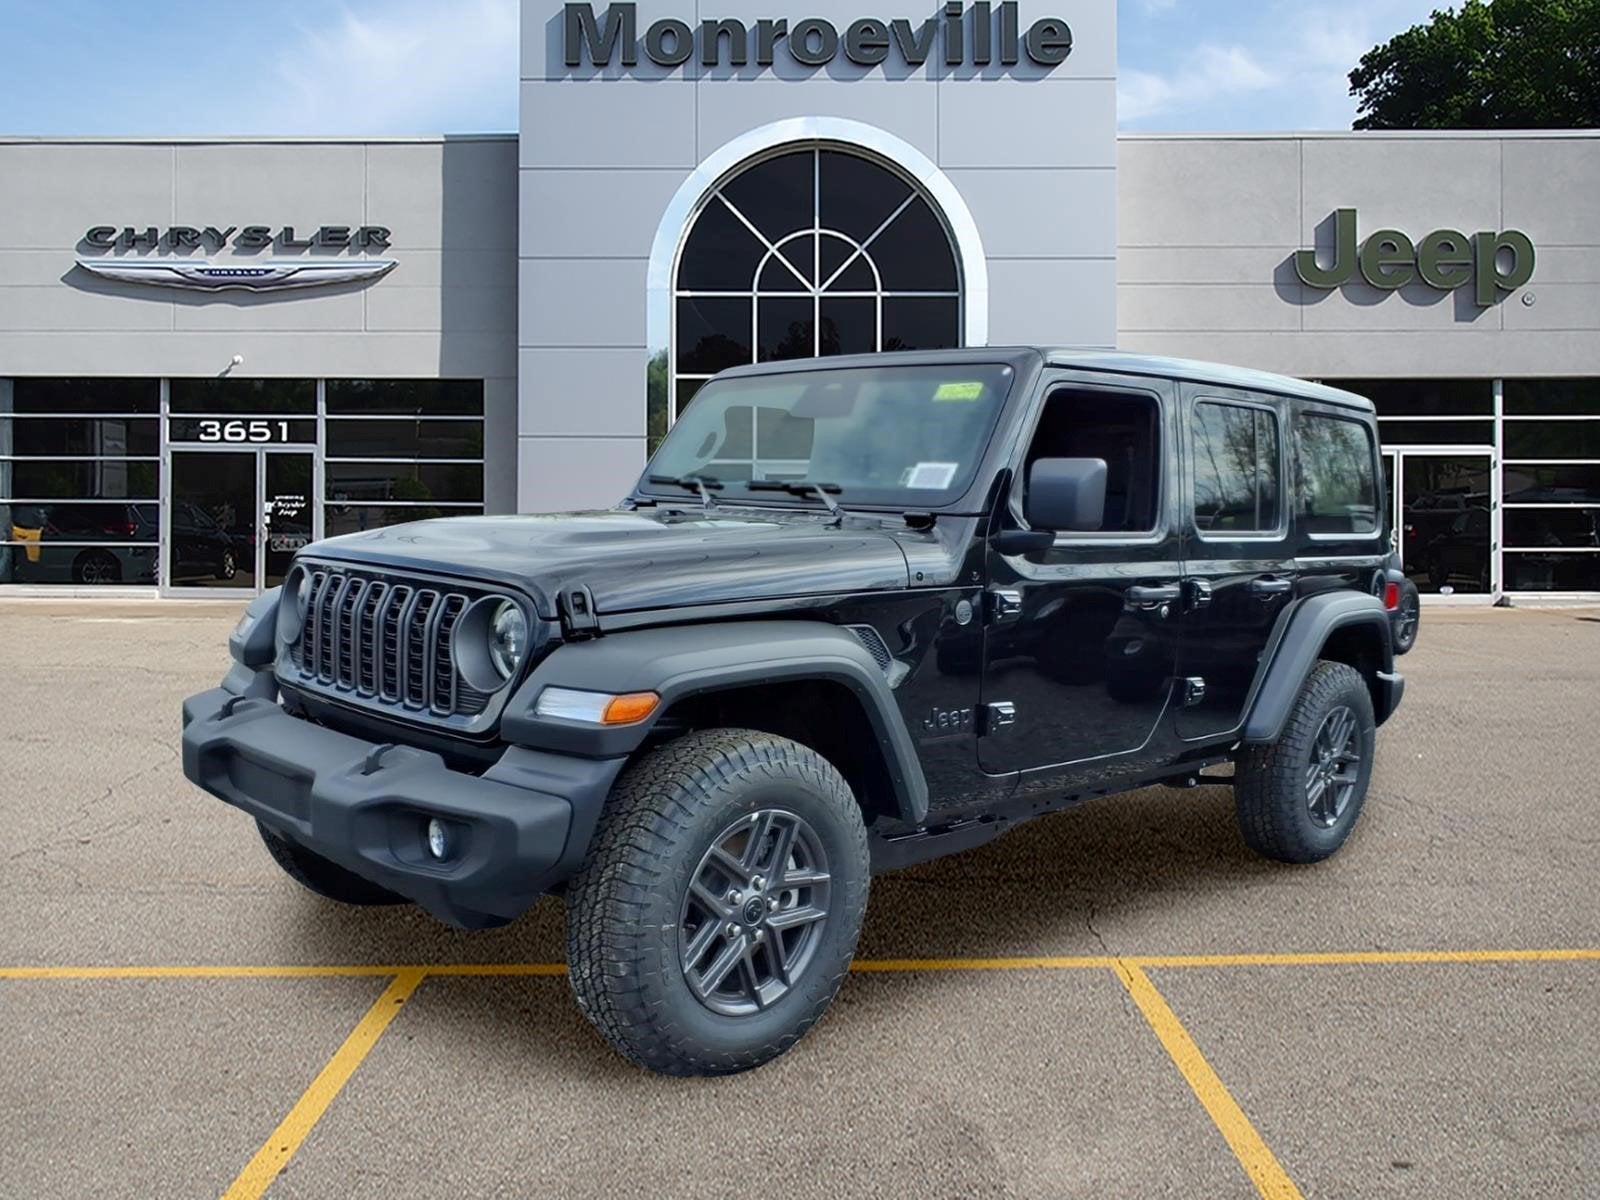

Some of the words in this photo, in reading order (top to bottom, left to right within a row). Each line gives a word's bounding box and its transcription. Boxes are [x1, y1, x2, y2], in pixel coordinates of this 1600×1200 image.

[564, 1, 1074, 67] Monroeville
[86, 226, 392, 247] CHRYSLER
[1294, 208, 1536, 306] Jeep
[199, 421, 288, 441] 3651
[923, 706, 974, 729] Jeep
